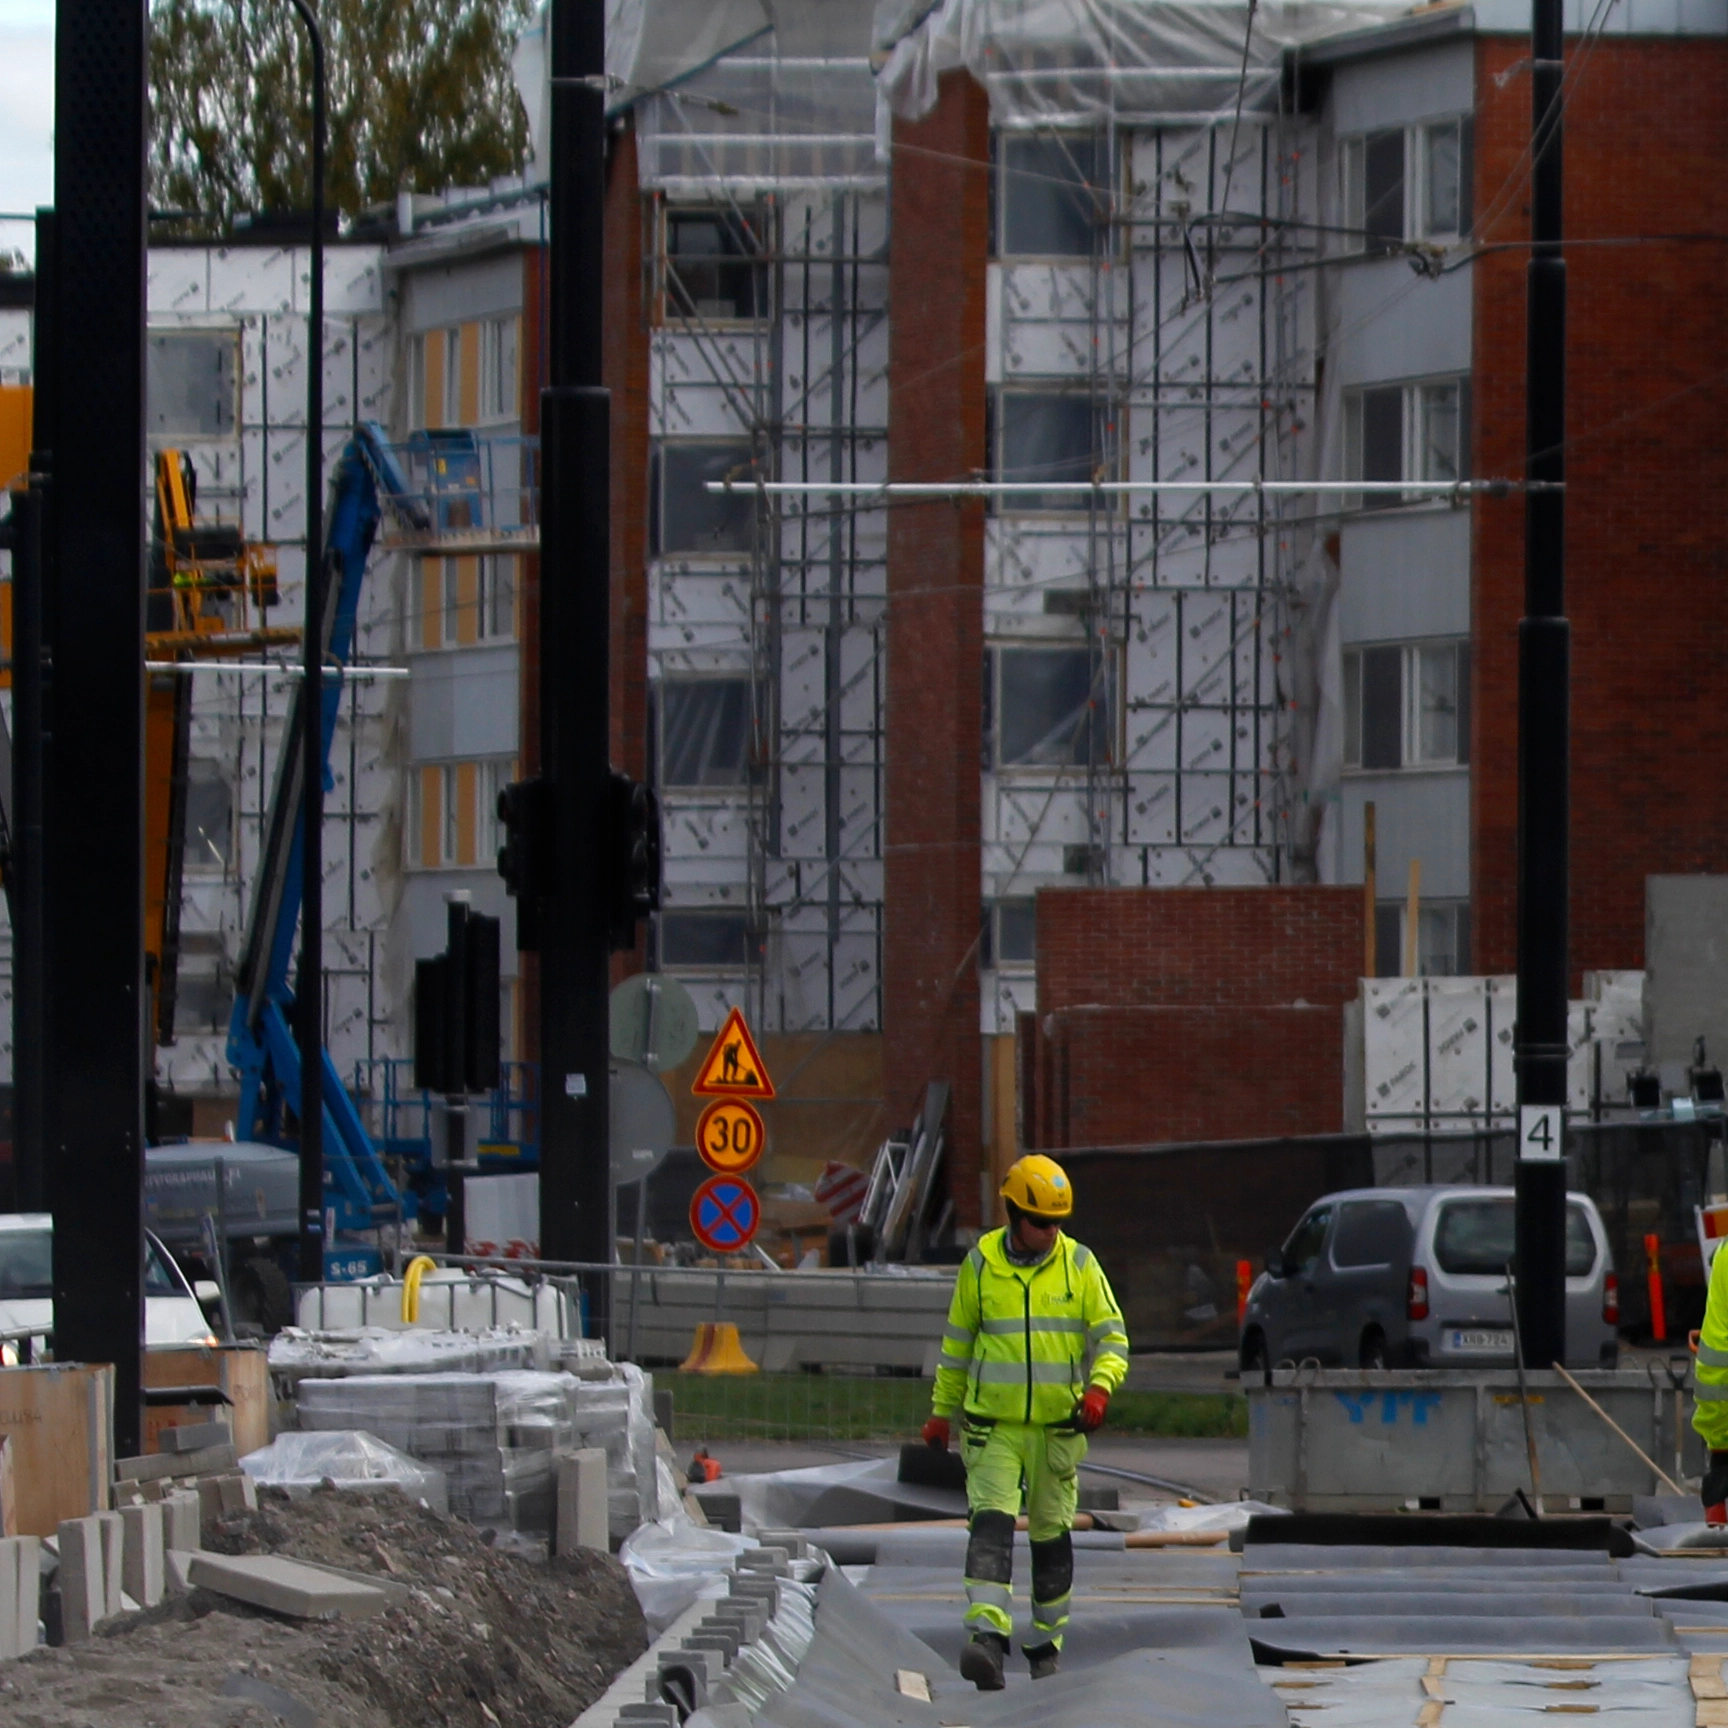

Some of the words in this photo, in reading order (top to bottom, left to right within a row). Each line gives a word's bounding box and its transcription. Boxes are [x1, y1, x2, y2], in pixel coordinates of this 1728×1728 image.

[710, 1116, 751, 1154] 30
[1527, 1114, 1554, 1151] 4
[330, 1260, 367, 1276] S-65
